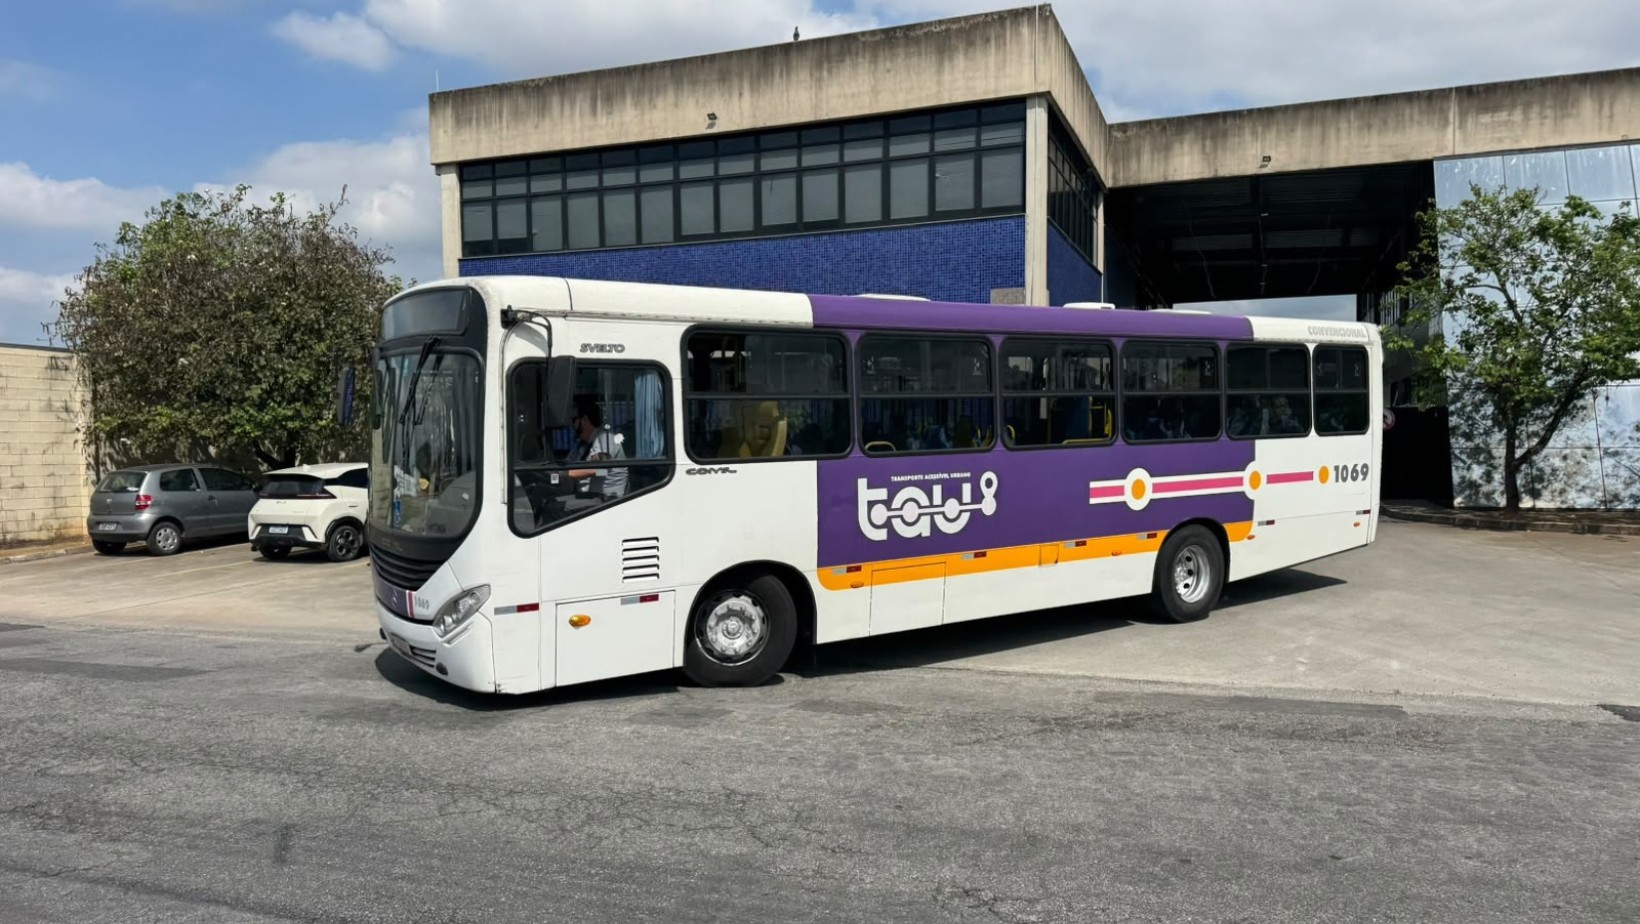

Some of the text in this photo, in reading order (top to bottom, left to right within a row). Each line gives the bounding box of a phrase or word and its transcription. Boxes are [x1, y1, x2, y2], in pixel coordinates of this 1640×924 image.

[1308, 326, 1366, 338] CONVENCIONAL
[580, 343, 626, 353] SVELTO
[1334, 463, 1369, 483] 1069
